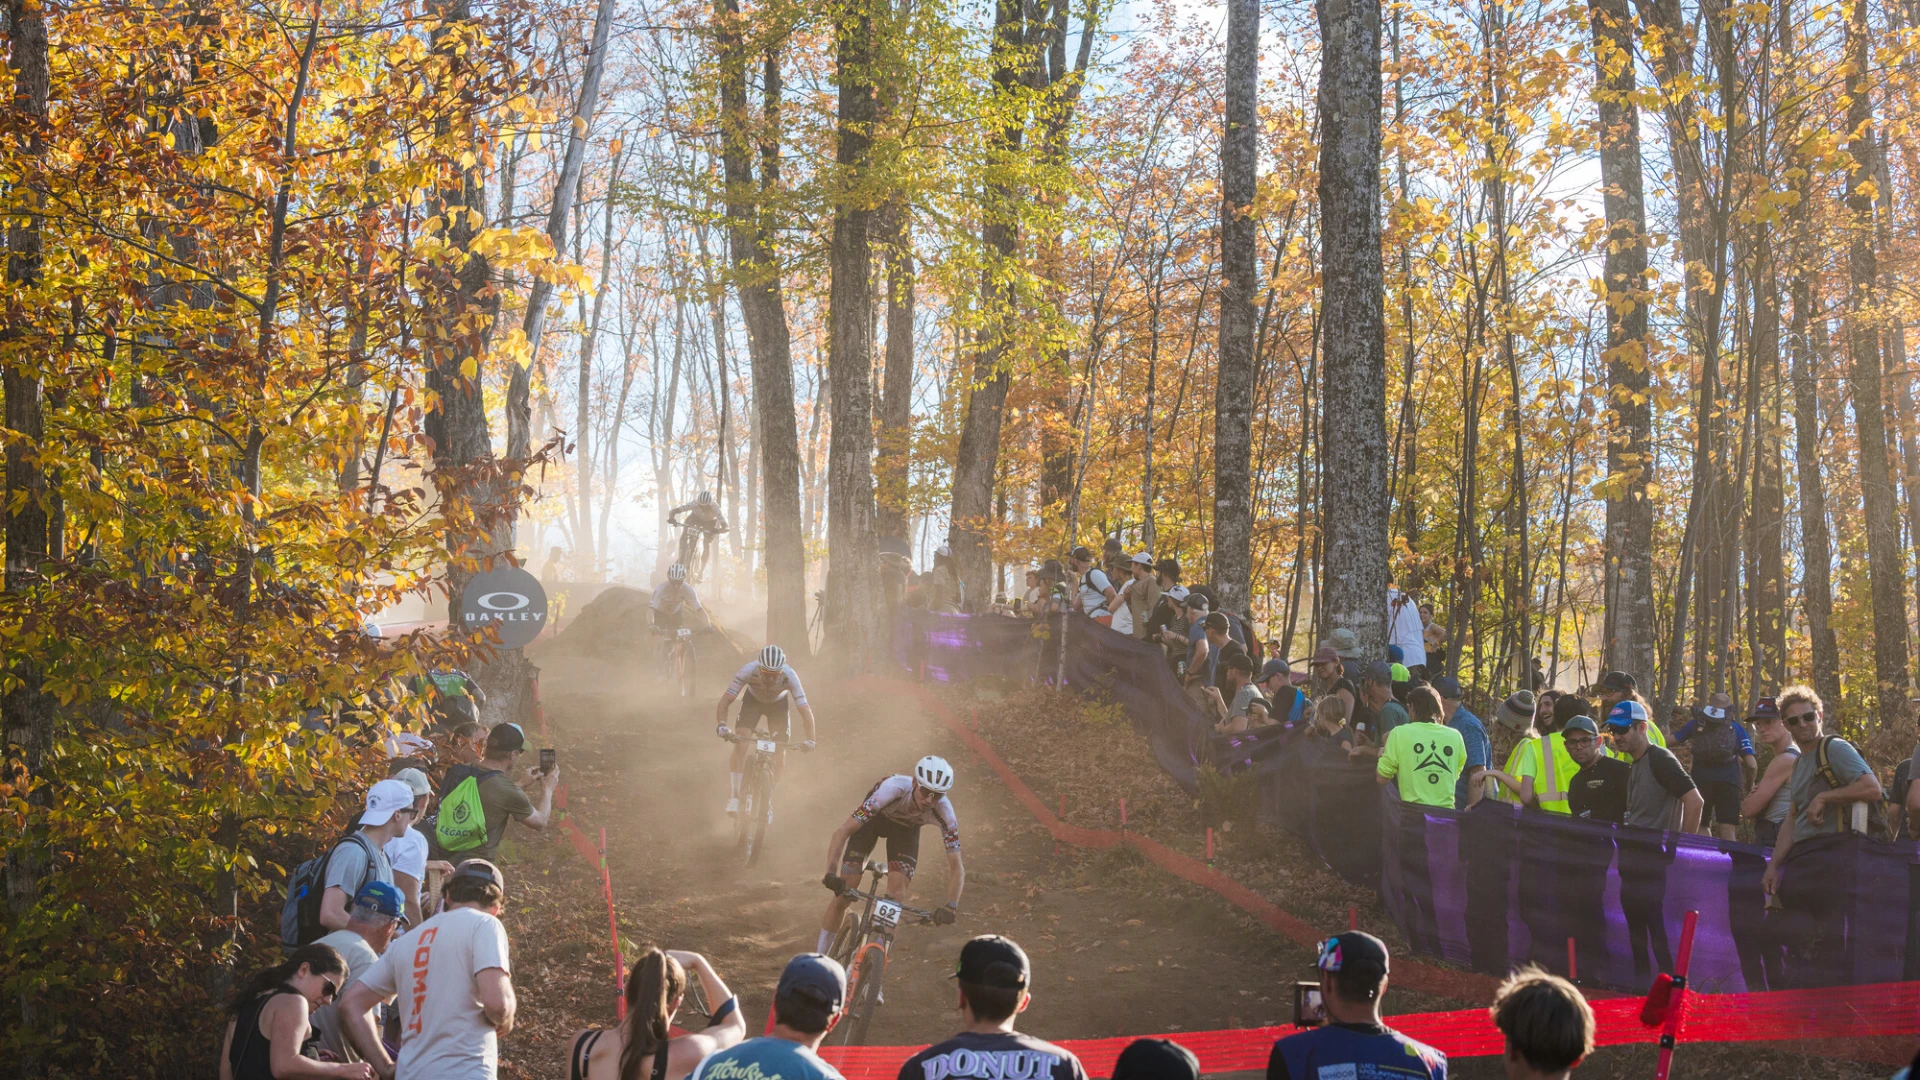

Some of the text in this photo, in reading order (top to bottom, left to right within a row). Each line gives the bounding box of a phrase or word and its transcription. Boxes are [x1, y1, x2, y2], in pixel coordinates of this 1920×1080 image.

[465, 612, 543, 621] OAKLEY
[440, 825, 474, 837] LEGACY
[879, 904, 896, 920] 62
[921, 1048, 1060, 1080] DONUT
